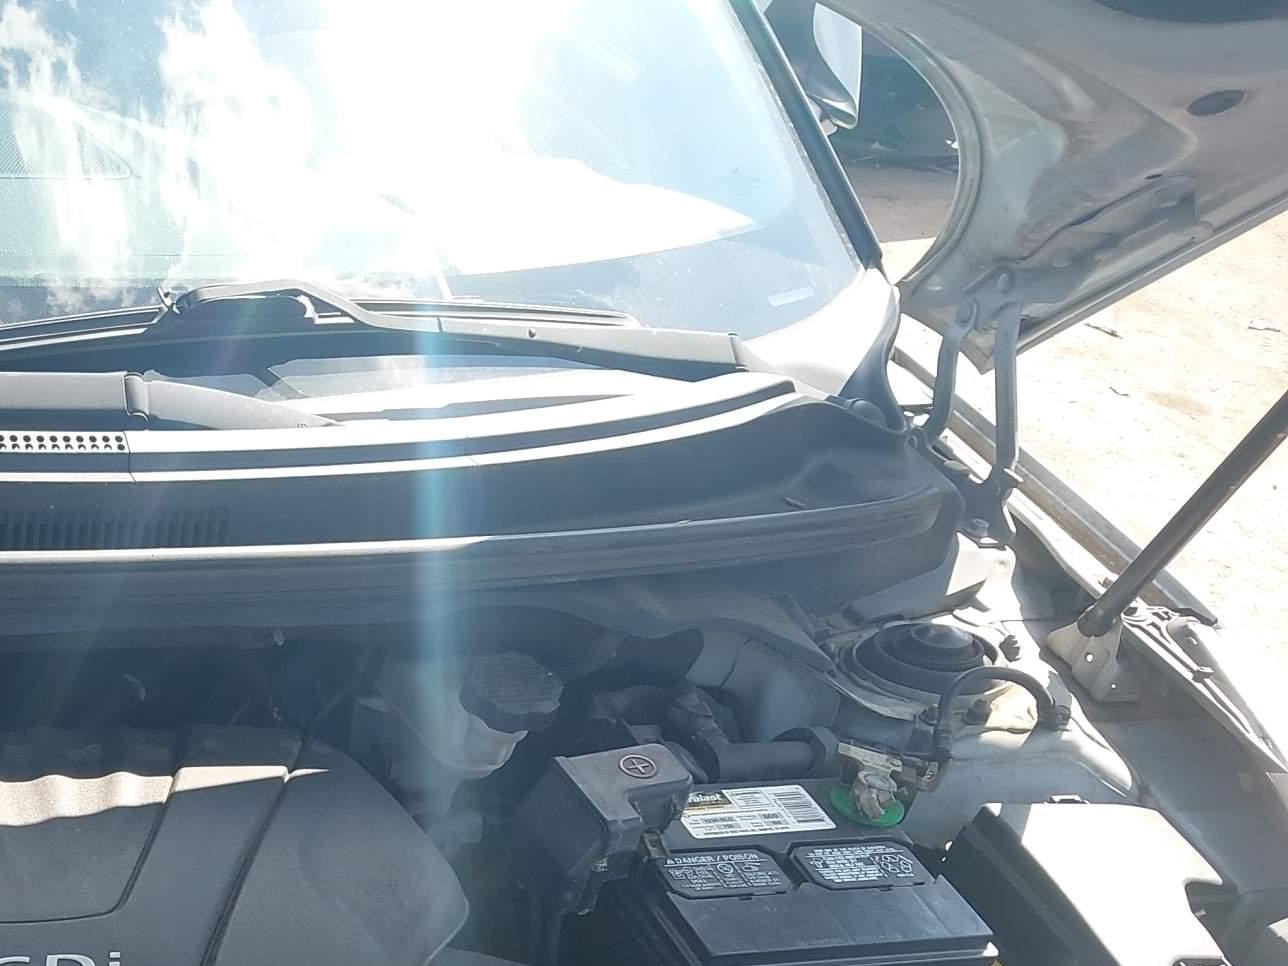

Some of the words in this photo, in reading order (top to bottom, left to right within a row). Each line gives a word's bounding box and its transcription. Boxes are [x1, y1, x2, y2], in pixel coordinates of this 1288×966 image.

[687, 793, 723, 803] ralast
[674, 855, 715, 864] DANGER
[722, 853, 759, 861] POISON
